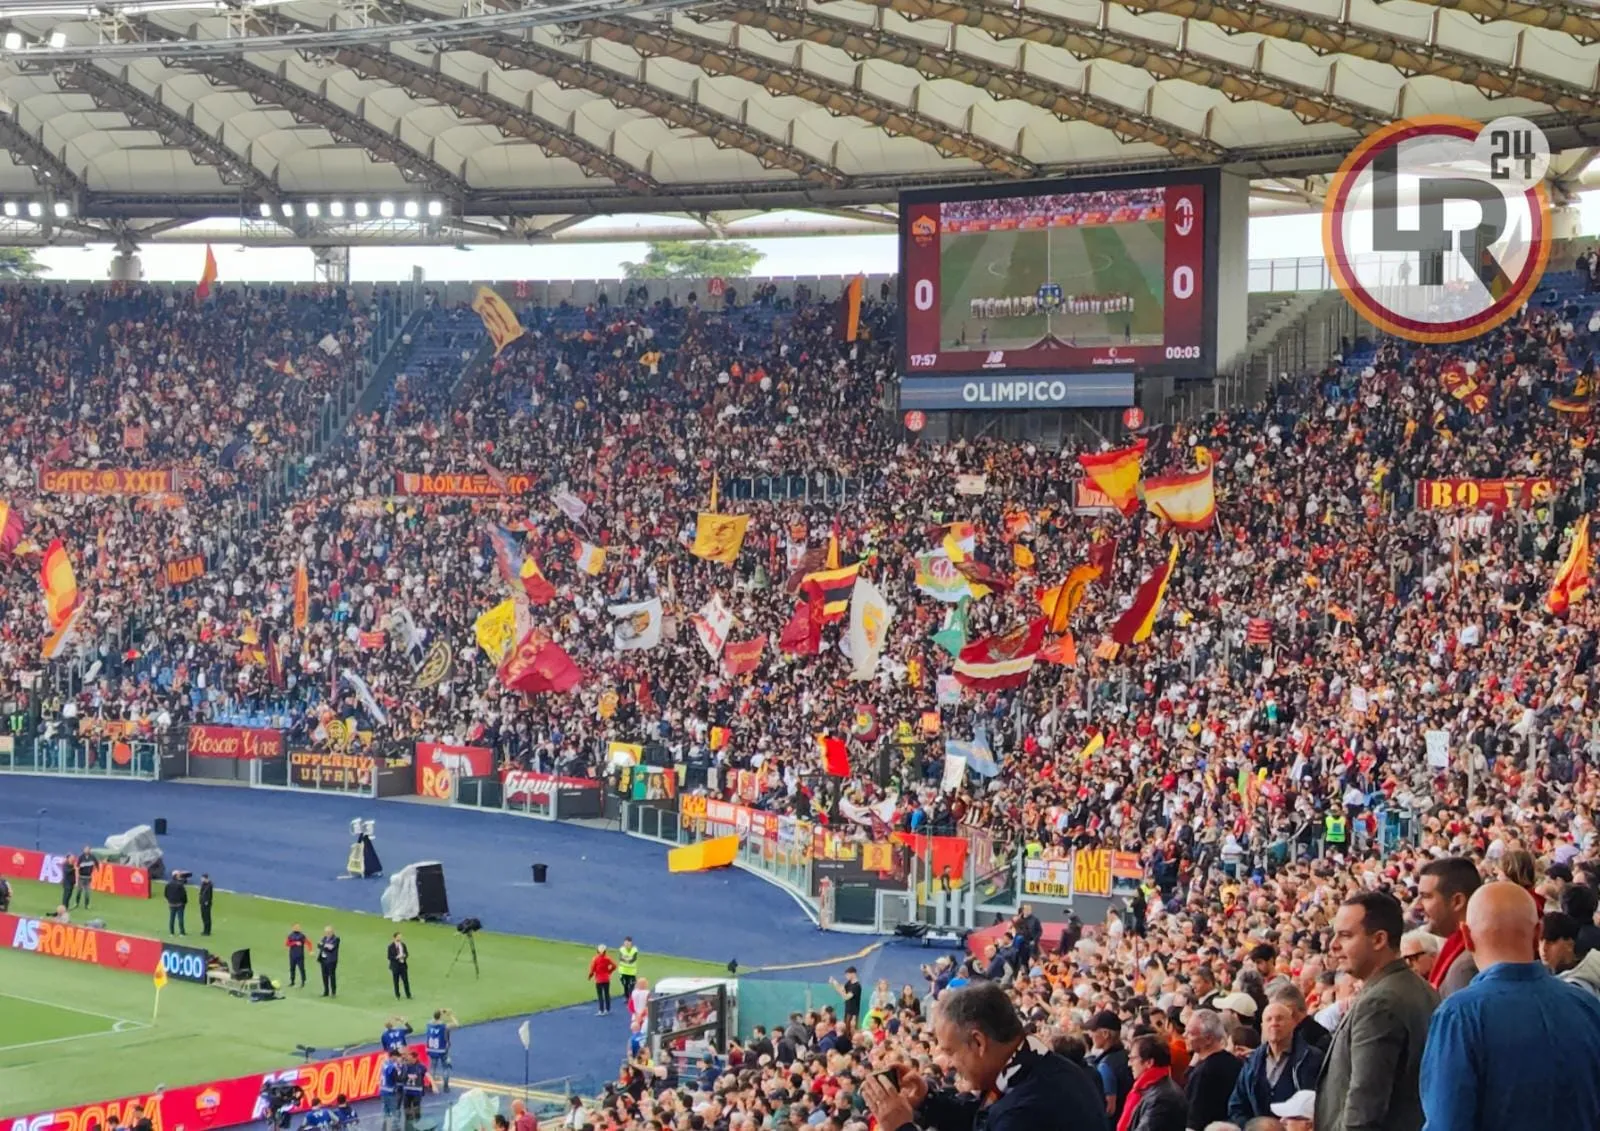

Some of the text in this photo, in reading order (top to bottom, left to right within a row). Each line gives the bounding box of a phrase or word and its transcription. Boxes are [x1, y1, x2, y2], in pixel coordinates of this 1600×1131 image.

[1172, 266, 1195, 299] 0
[914, 279, 934, 311] 0
[910, 354, 937, 367] 17:57
[1165, 346, 1200, 359] 00:03
[962, 381, 1066, 402] OLIMPICO
[43, 471, 167, 492] GATE XXII
[1076, 849, 1113, 870] AVE
[1073, 869, 1110, 894] MOU
[161, 951, 203, 977] 00:00
